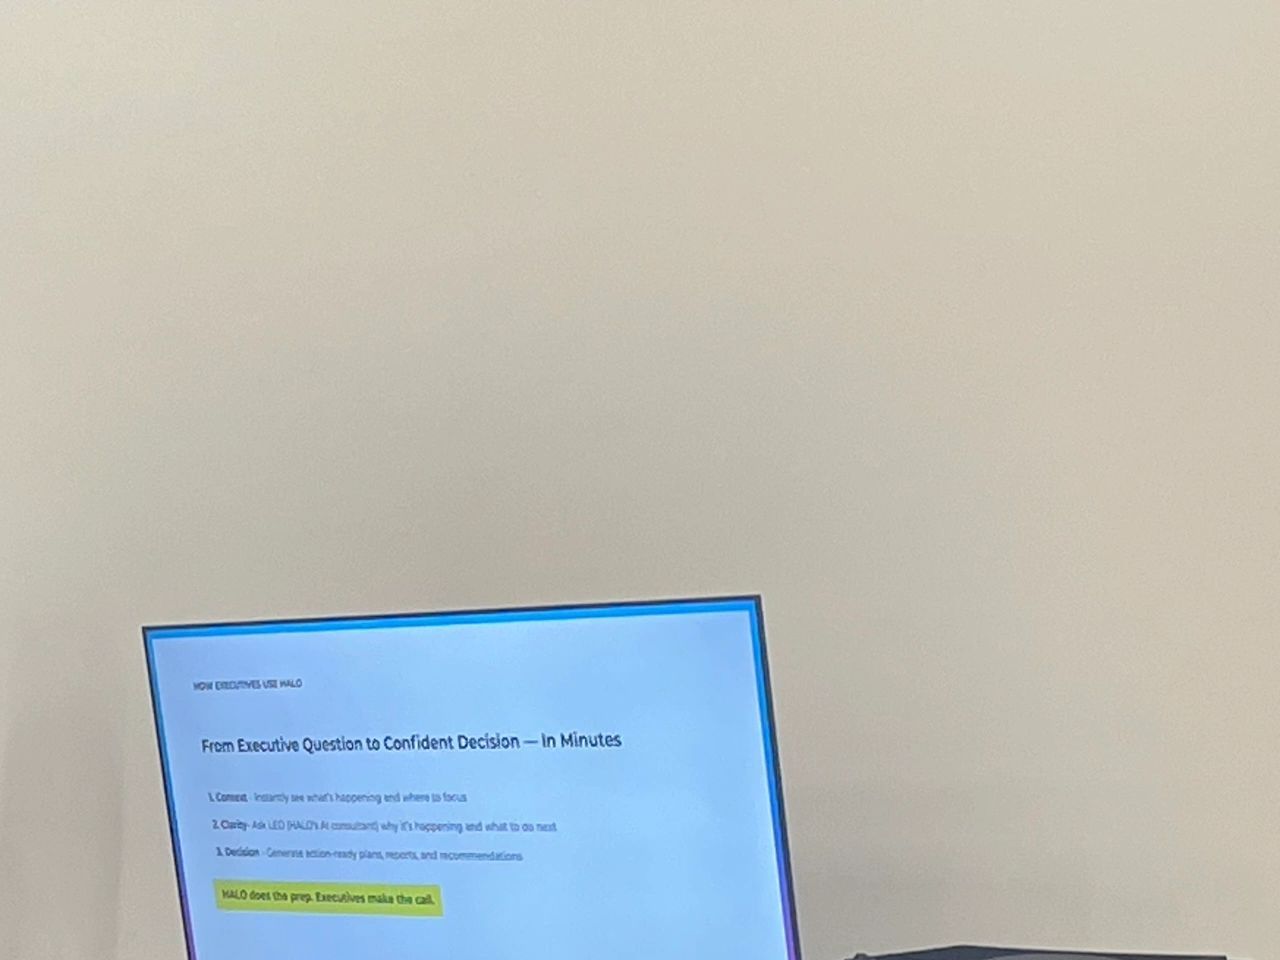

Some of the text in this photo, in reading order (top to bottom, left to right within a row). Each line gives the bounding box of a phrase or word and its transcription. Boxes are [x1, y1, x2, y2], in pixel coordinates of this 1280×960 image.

[193, 678, 303, 691] HOW EXECUTIVES USE HALO
[201, 738, 235, 753] From
[237, 736, 300, 752] Executive
[302, 735, 363, 754] Question
[366, 737, 380, 751] to
[384, 734, 454, 751] Confident
[457, 732, 520, 750] Decision
[541, 733, 556, 748] In
[560, 731, 622, 748] Minutes
[335, 792, 381, 804] happening
[384, 792, 400, 802] and
[403, 792, 430, 802] where
[431, 793, 441, 802] to
[443, 792, 467, 802] focus
[381, 822, 398, 833] why
[415, 822, 462, 834] happening
[465, 822, 482, 831] and
[485, 822, 508, 831] what
[509, 822, 519, 832] to
[522, 822, 534, 832] do
[536, 822, 557, 832] next
[224, 847, 260, 857] Decision
[421, 850, 437, 860] and
[439, 850, 524, 861] recommendations
[222, 888, 435, 905] HALO does the prep. Executives make the call.
